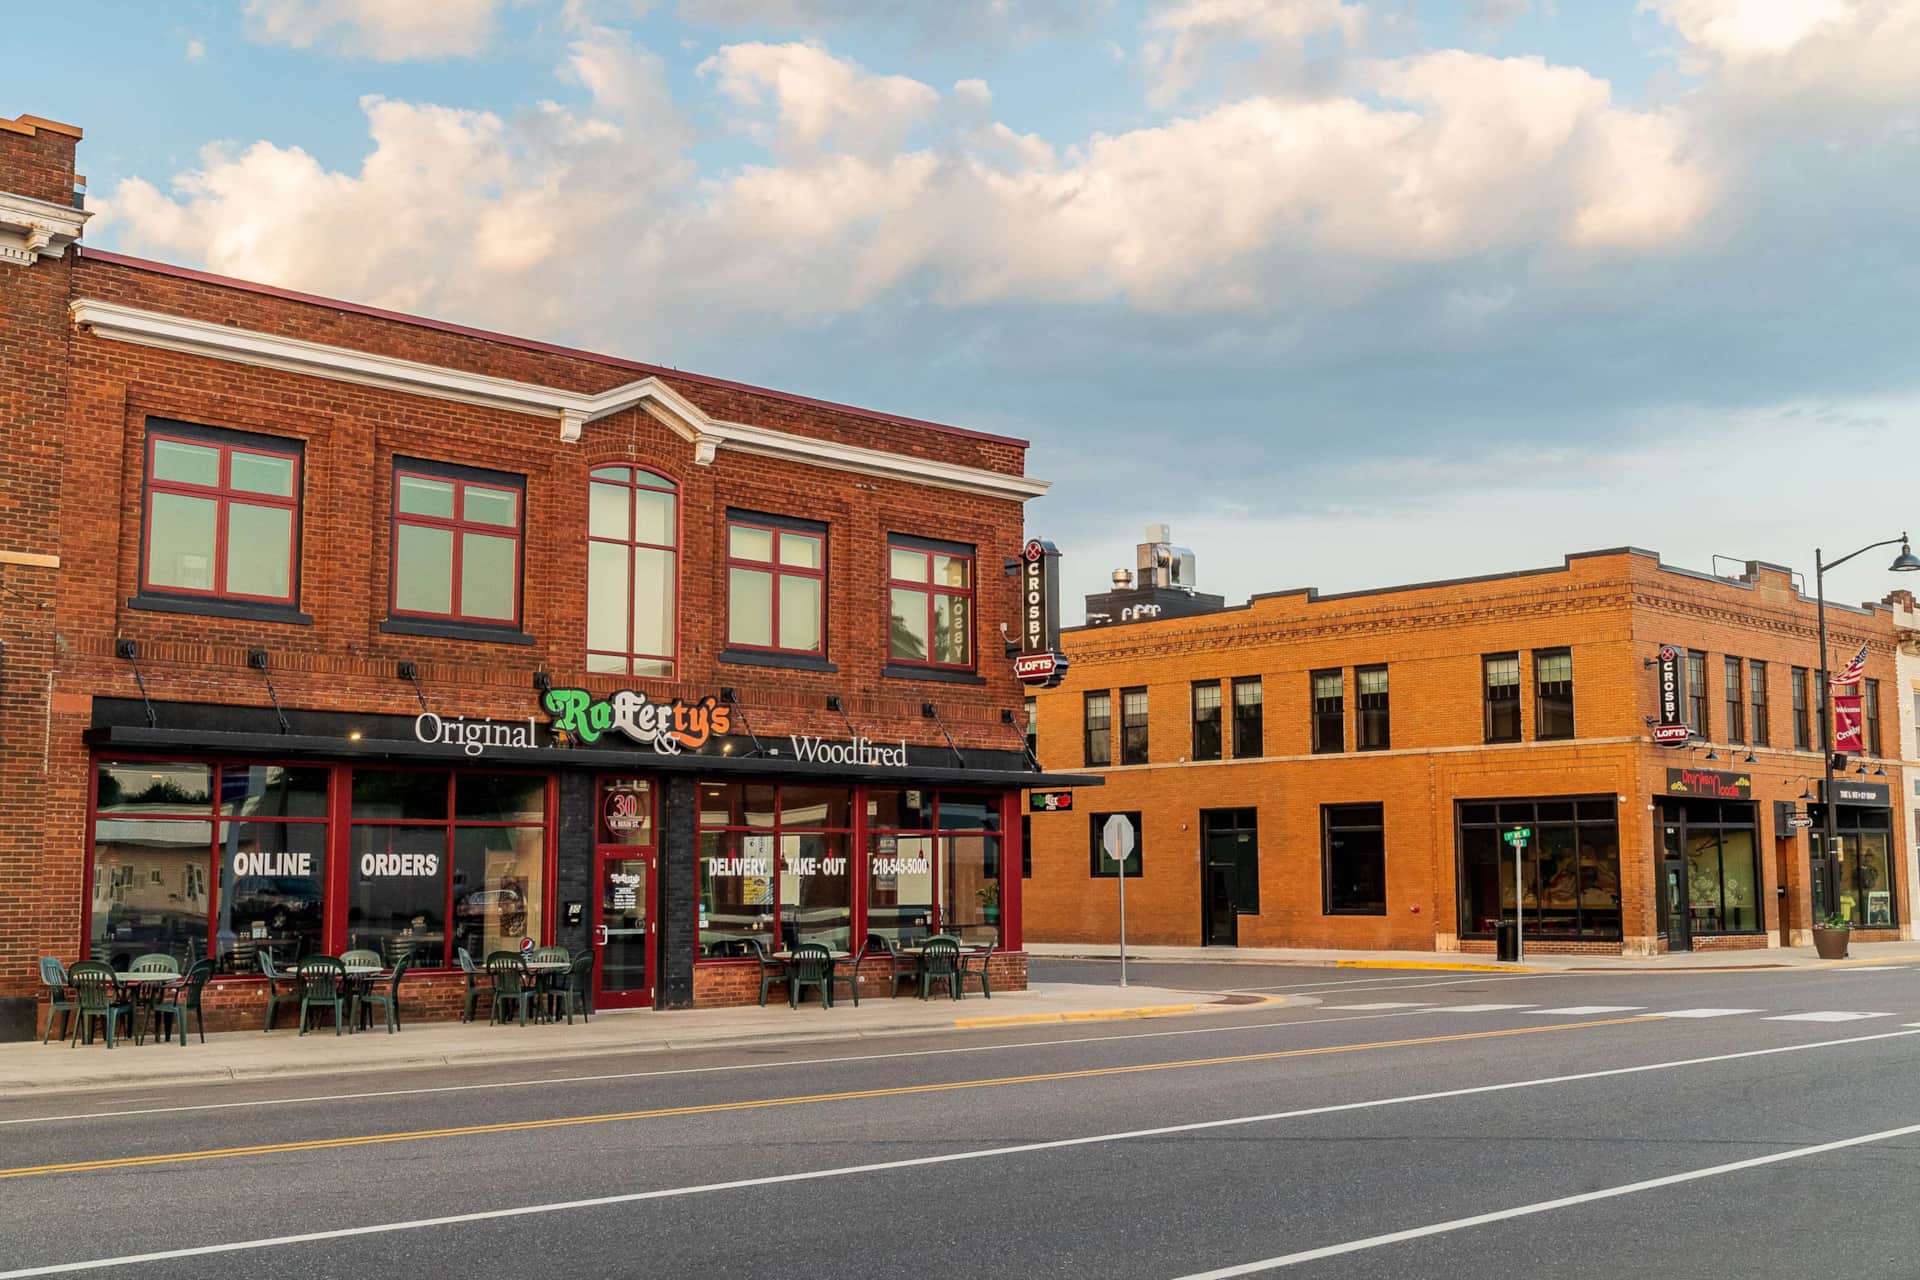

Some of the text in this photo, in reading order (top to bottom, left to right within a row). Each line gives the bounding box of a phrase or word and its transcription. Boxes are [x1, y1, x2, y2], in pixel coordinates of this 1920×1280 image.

[1028, 563, 1040, 649] CROSBY
[1019, 660, 1052, 672] LOFTS
[1663, 662, 1675, 722] CROSBY
[546, 689, 731, 747] Rafferty's
[415, 713, 538, 756] Original
[790, 734, 908, 767] Woodfired
[1656, 729, 1686, 738] LOFTS
[613, 794, 638, 817] 30
[233, 852, 437, 876] ONLINE ORDERS
[709, 857, 928, 876] DELIVERY TAKE-OUT 218-545-5000
